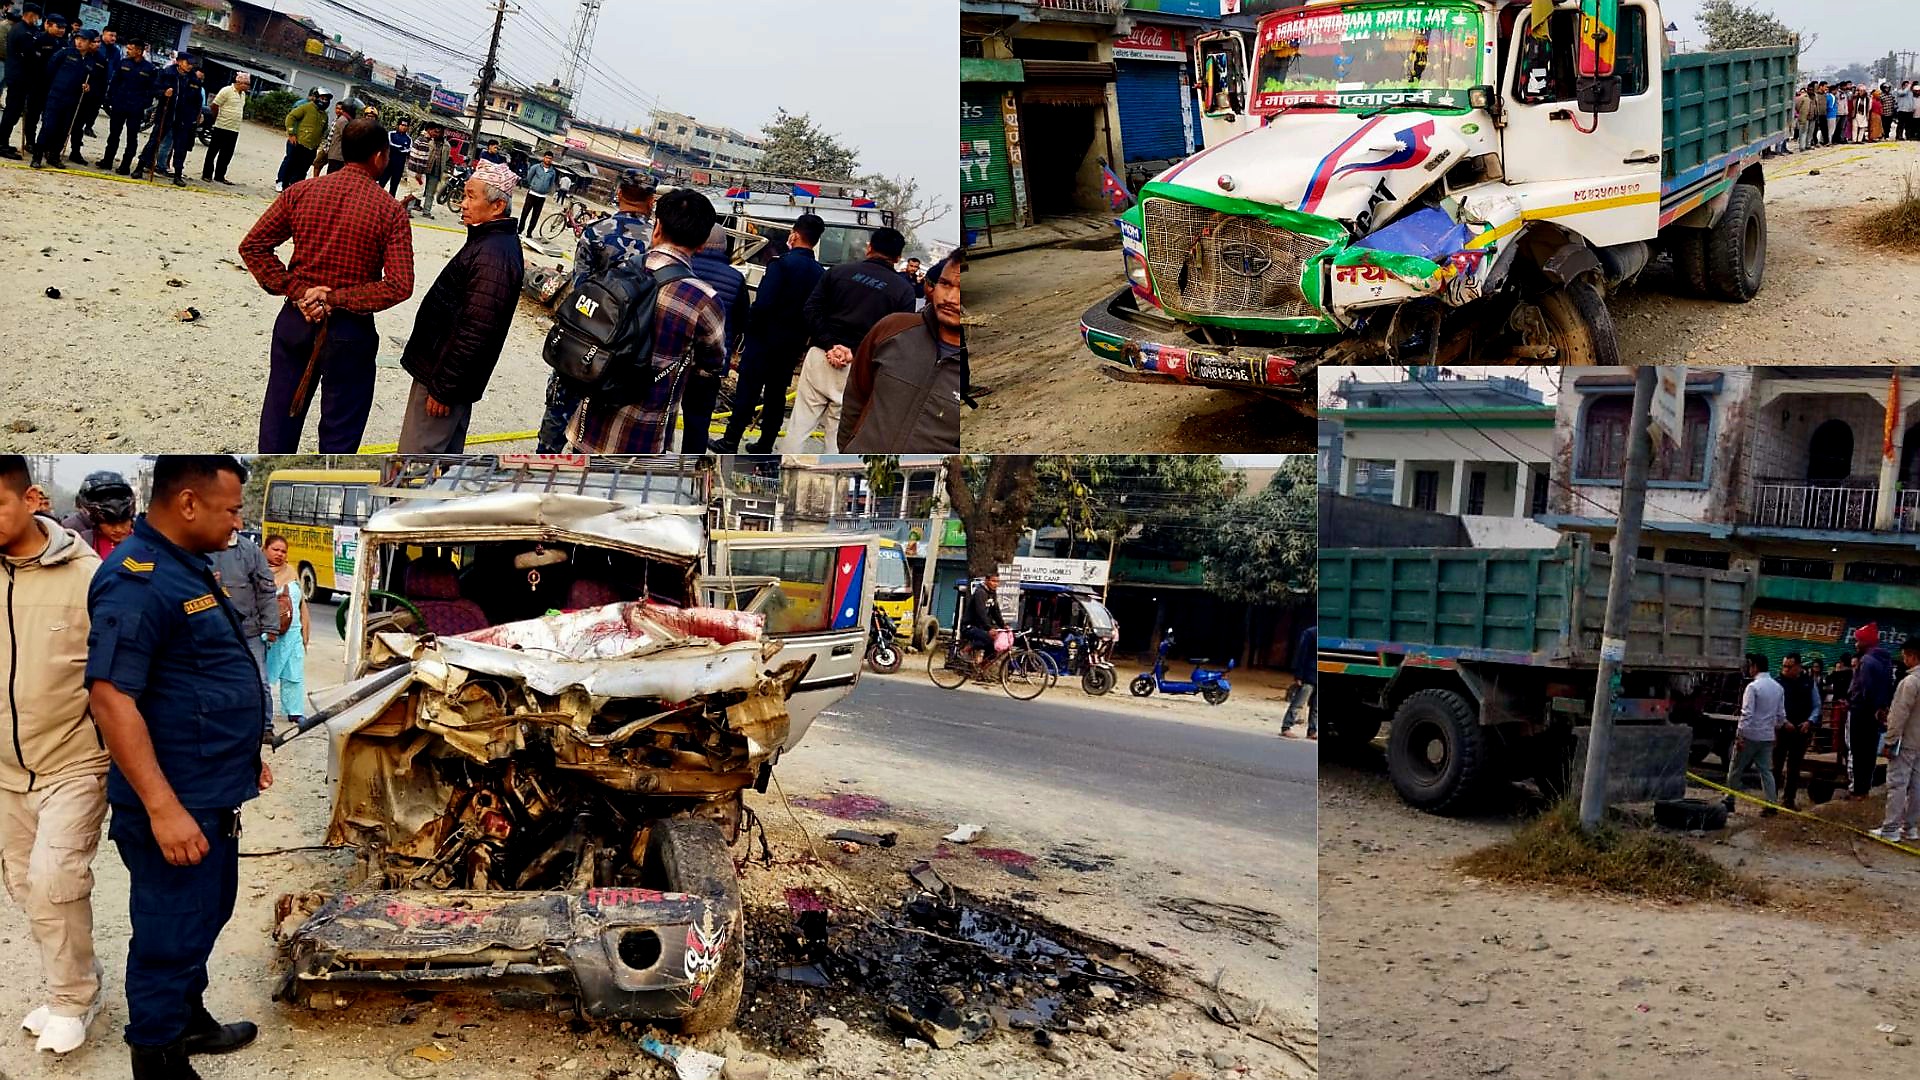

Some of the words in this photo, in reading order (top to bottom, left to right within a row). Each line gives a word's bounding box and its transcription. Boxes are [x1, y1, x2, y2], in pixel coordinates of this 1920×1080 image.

[1375, 13, 1403, 29] DEVI
[1406, 12, 1421, 27] KI
[1424, 9, 1449, 27] JAY
[575, 294, 599, 318] CAT
[1753, 614, 1841, 638] Pashupati
